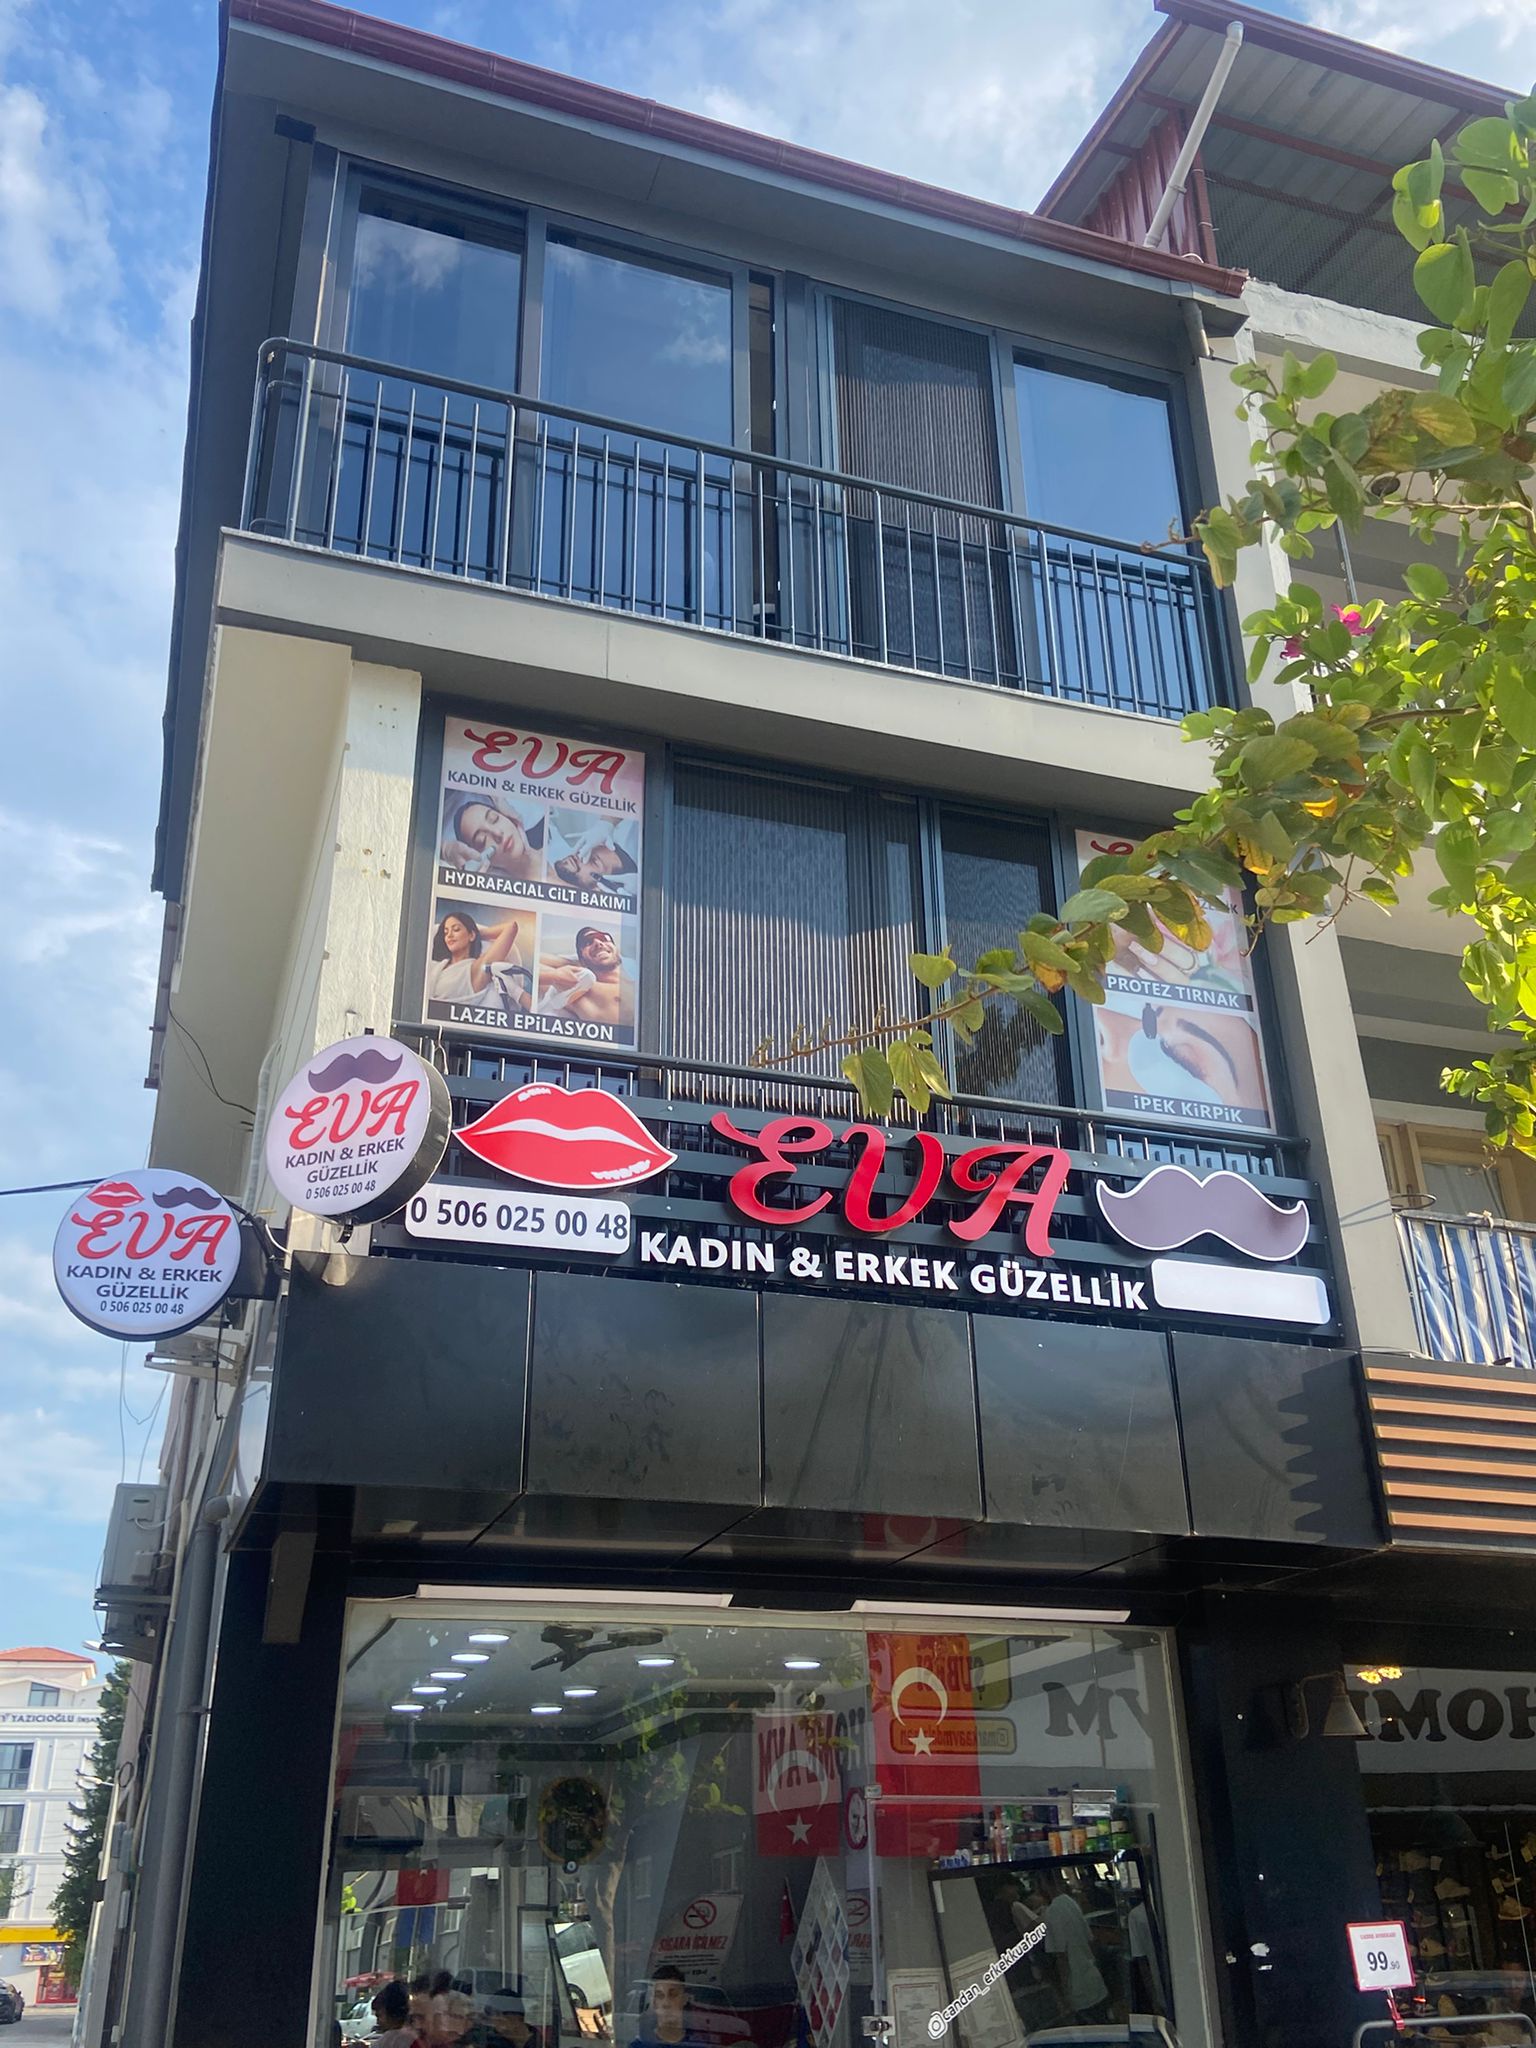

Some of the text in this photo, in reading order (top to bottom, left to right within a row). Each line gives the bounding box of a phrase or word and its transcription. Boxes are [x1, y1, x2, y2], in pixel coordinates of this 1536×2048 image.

[464, 728, 626, 794] EVA
[447, 770, 637, 814] KADIN & ERKEK GÜZELLİK
[445, 870, 545, 899] HYDRAFACIAL
[580, 891, 632, 912] BAKIMI
[1107, 975, 1241, 1008] PROTEZ TIRNAK
[450, 1005, 509, 1028] LAZER
[284, 1080, 420, 1150] EVA
[285, 1136, 405, 1169] KADIN & ERKEK
[306, 1158, 378, 1184] GÜZELLİK
[306, 1180, 376, 1200] 0 506 025 00 48
[710, 1111, 1072, 1257] EVA
[71, 1209, 231, 1265] EVA
[410, 1197, 628, 1240] 0 506 025 00 48
[66, 1265, 222, 1283] KADIN & ERKEK
[641, 1232, 1149, 1311] KADIN & ERKEK GÜZELLİK
[96, 1281, 189, 1300] GÜZELLİK
[100, 1301, 184, 1315] 0 506 025 00 48
